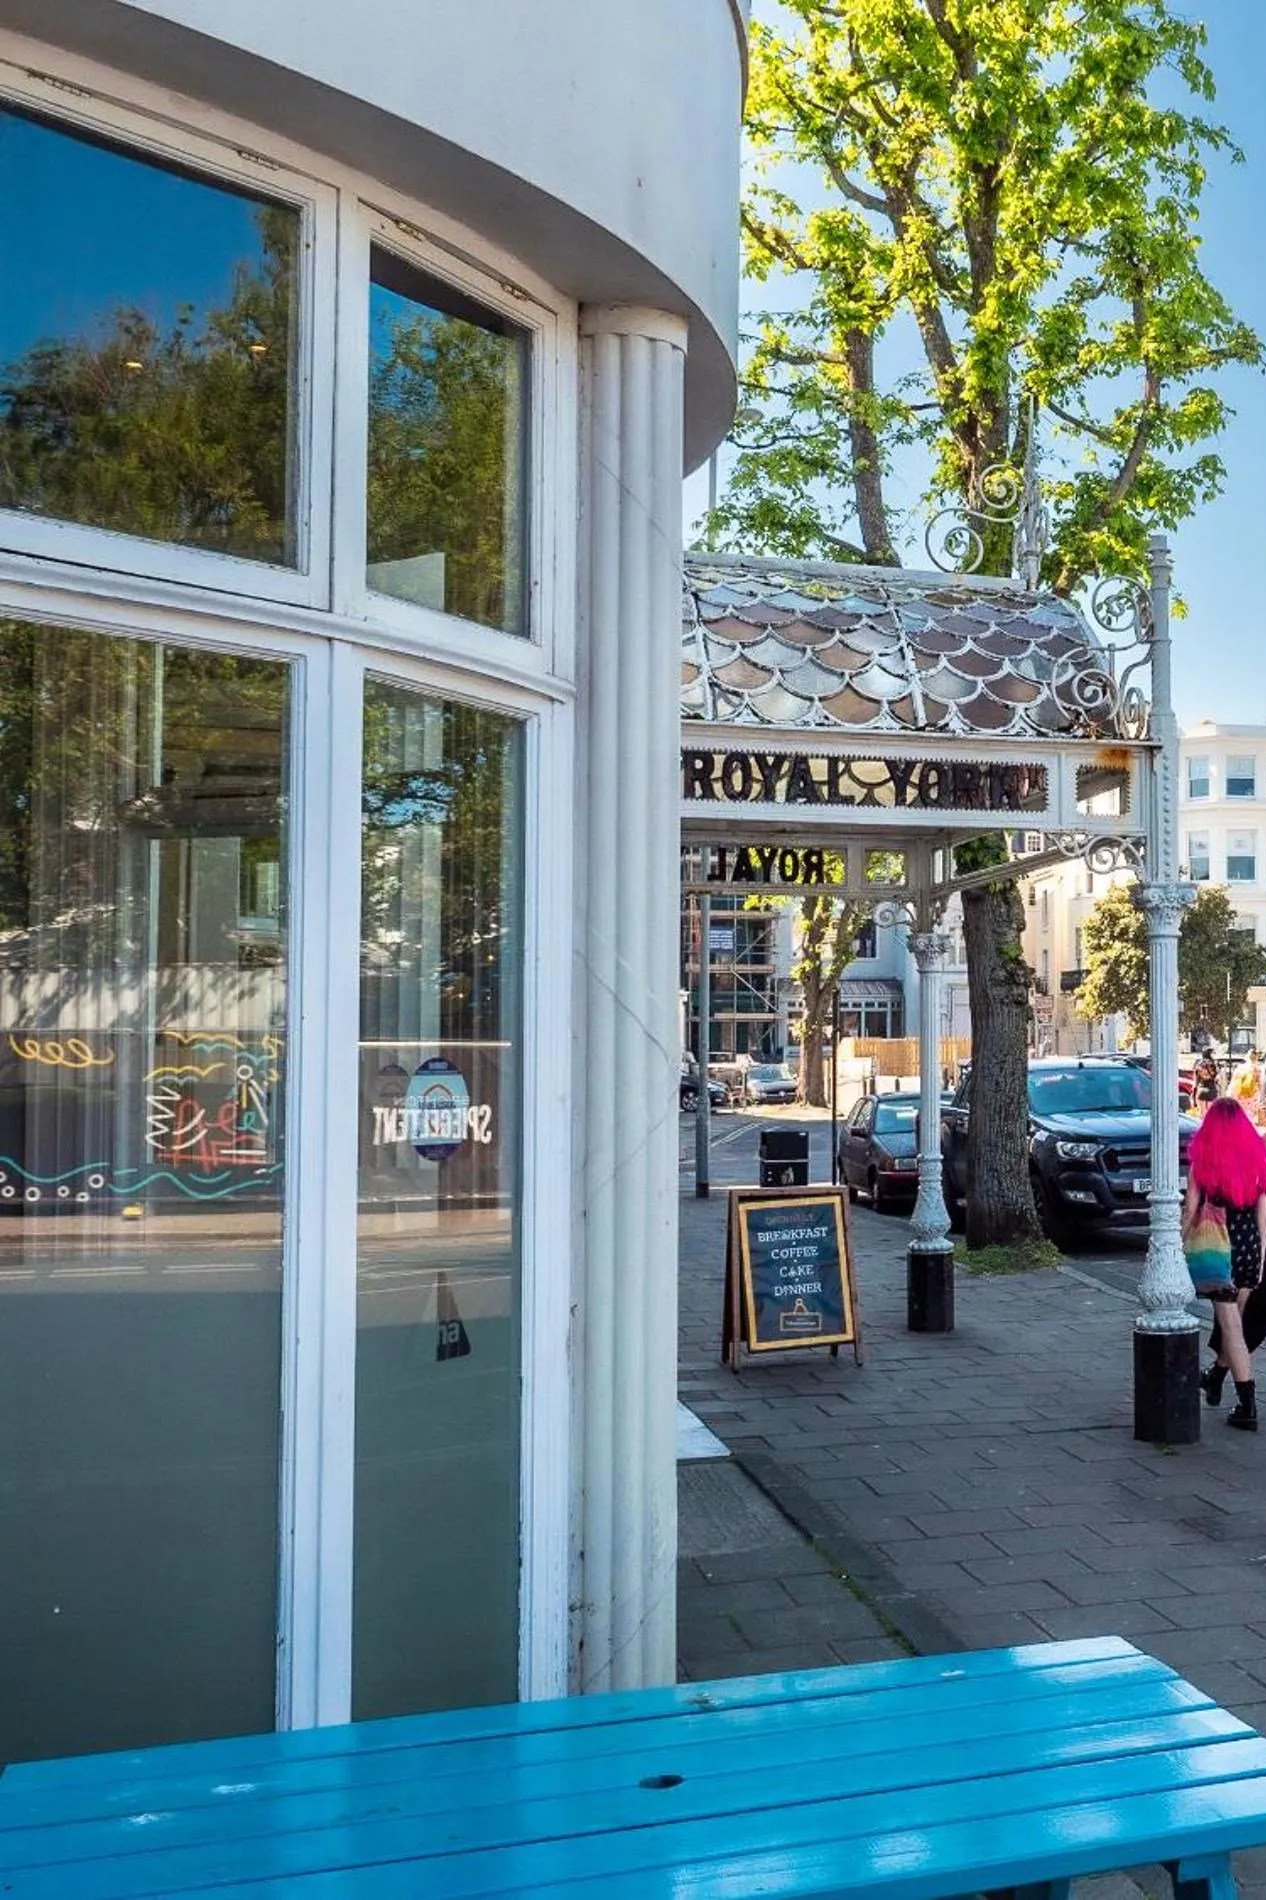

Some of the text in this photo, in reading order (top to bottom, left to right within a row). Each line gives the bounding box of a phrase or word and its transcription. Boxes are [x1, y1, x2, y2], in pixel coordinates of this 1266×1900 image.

[682, 749, 1019, 811] ROYAL YORK
[757, 1226, 828, 1242] BREAKFAST
[771, 1246, 819, 1260] COFFEE
[779, 1264, 815, 1278] CAKE
[774, 1282, 822, 1297] DINNER
